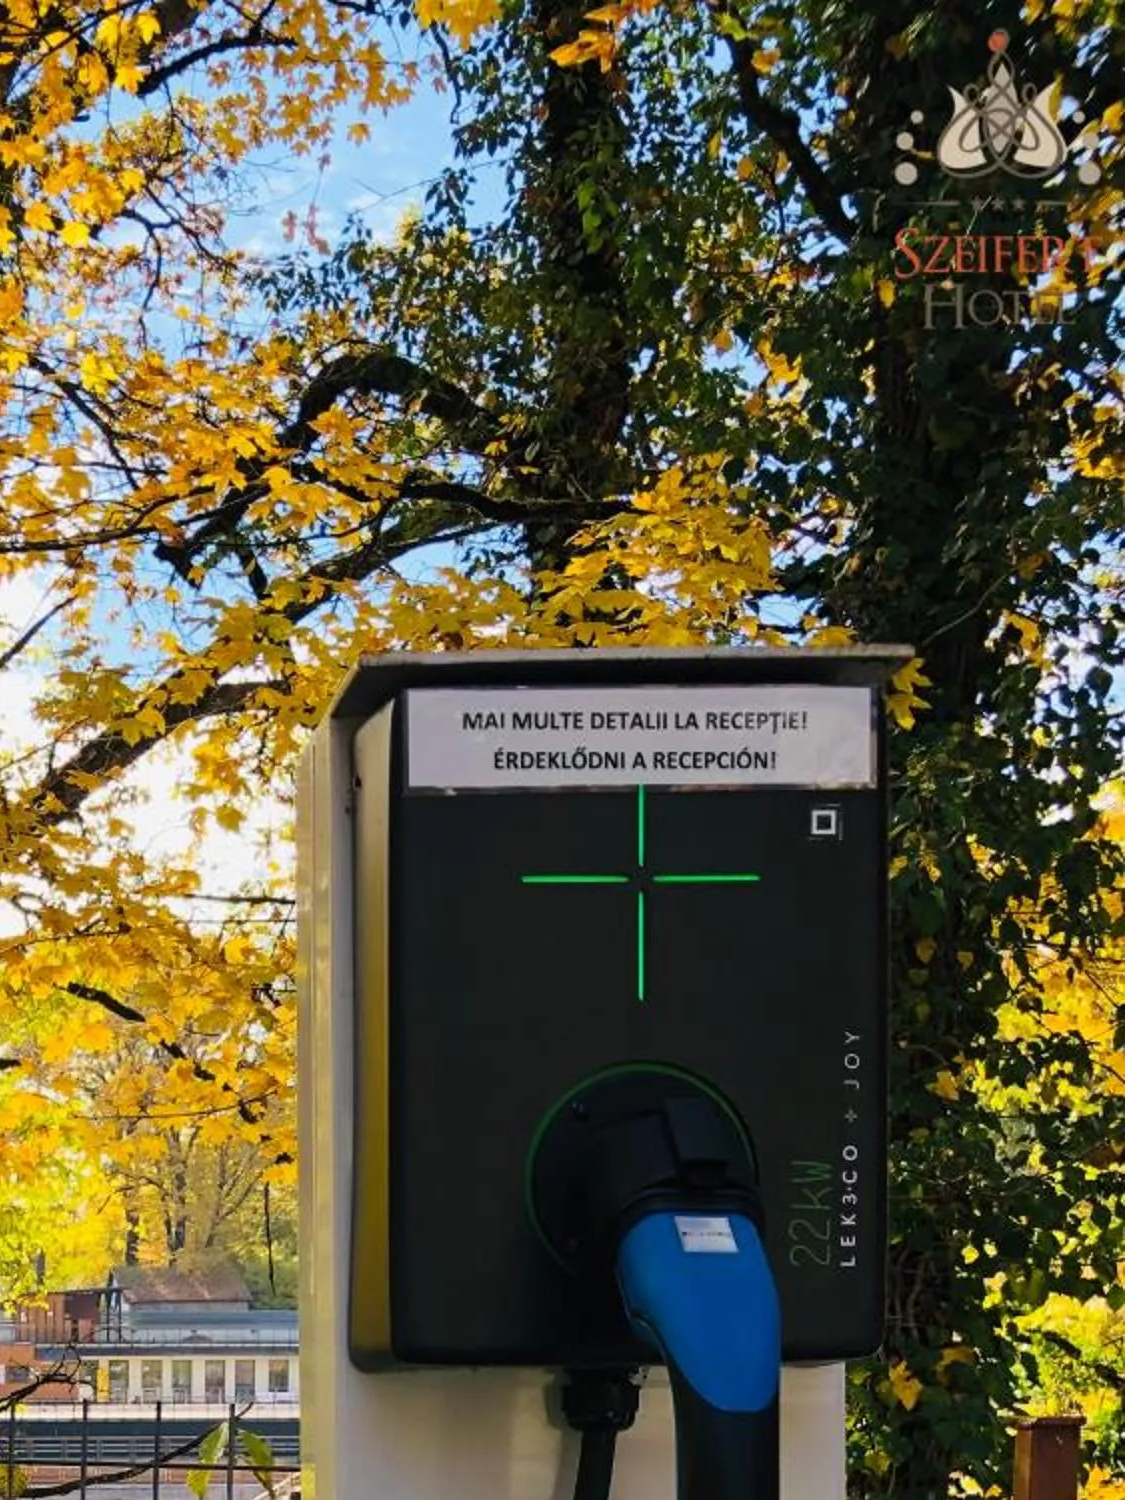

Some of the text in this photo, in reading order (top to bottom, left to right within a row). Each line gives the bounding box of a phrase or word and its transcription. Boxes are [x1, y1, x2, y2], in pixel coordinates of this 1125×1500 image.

[462, 711, 506, 730] MAI
[511, 711, 584, 730] MULTE
[590, 711, 668, 730] DETALII
[674, 711, 699, 730] LA
[493, 746, 777, 769] ÉRDEKLŐDNI A RECEPCIÓN!
[843, 1031, 860, 1090] JOY
